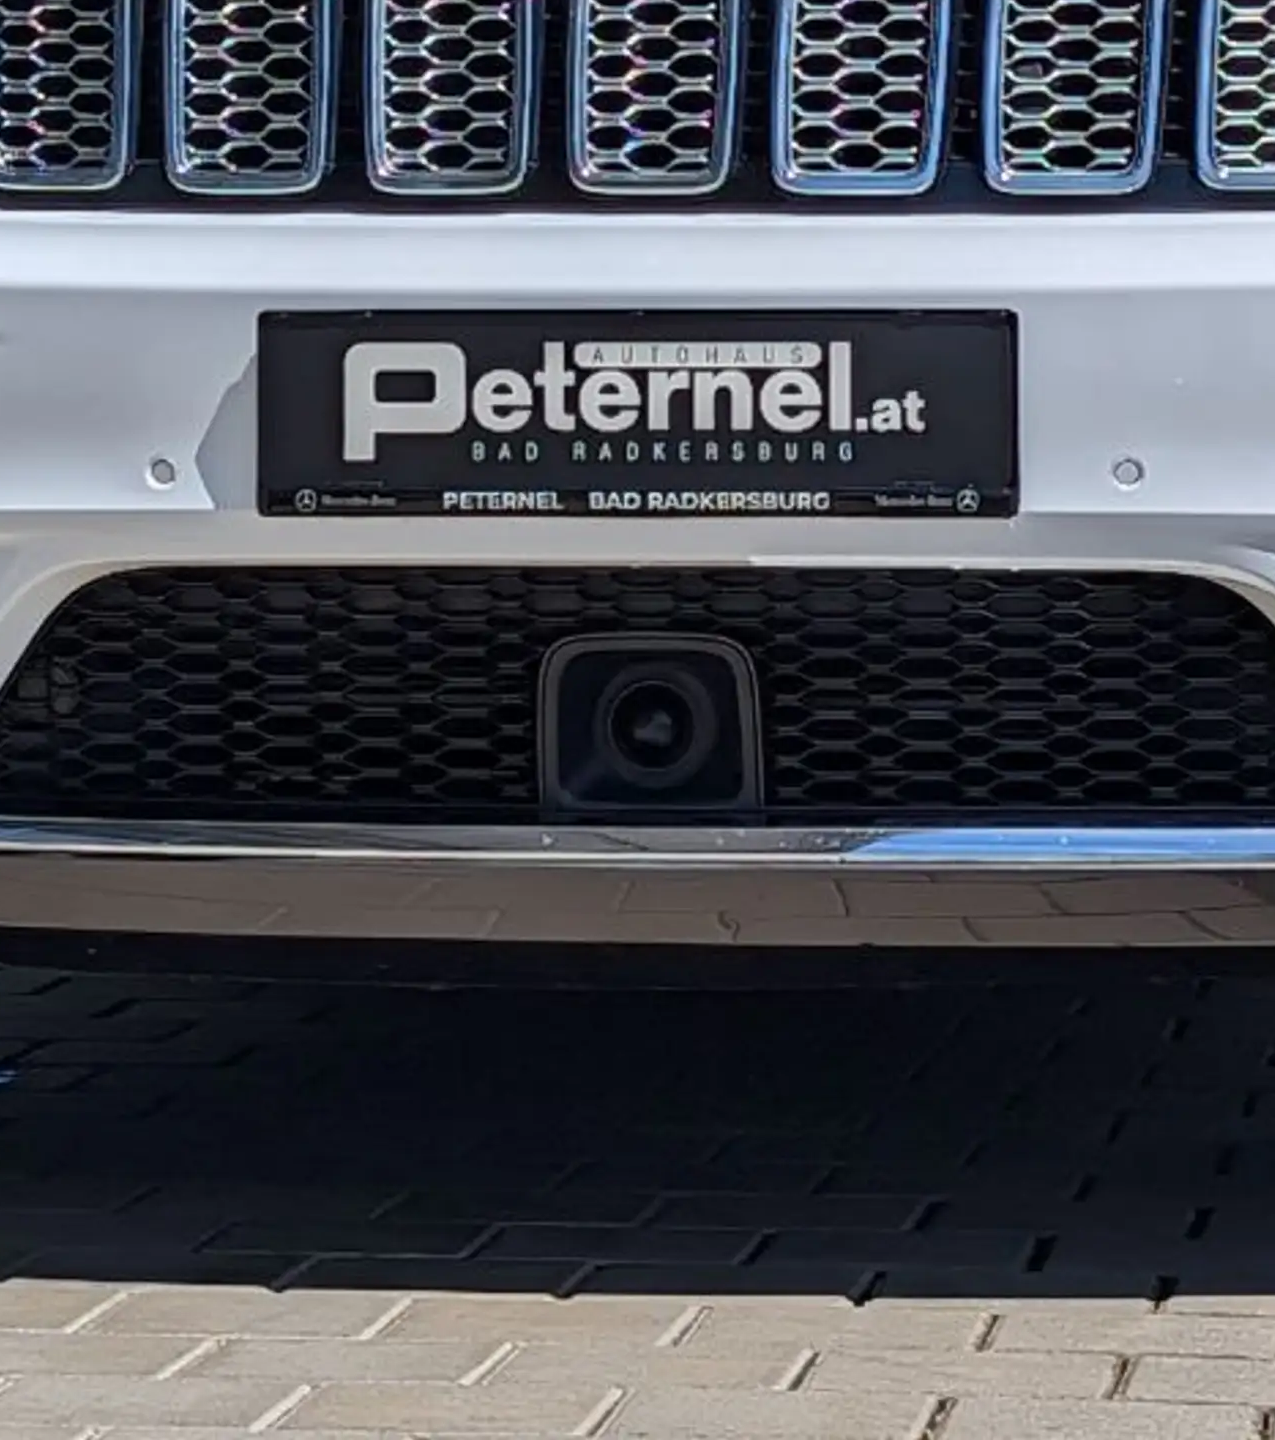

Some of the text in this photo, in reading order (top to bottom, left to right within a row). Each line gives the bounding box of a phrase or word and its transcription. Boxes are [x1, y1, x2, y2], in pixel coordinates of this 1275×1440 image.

[592, 346, 804, 364] AUTOHAUS
[472, 440, 853, 462] BAD RADKERSBURG
[442, 491, 830, 510] PETERNEL BAD RADKERSBURG
